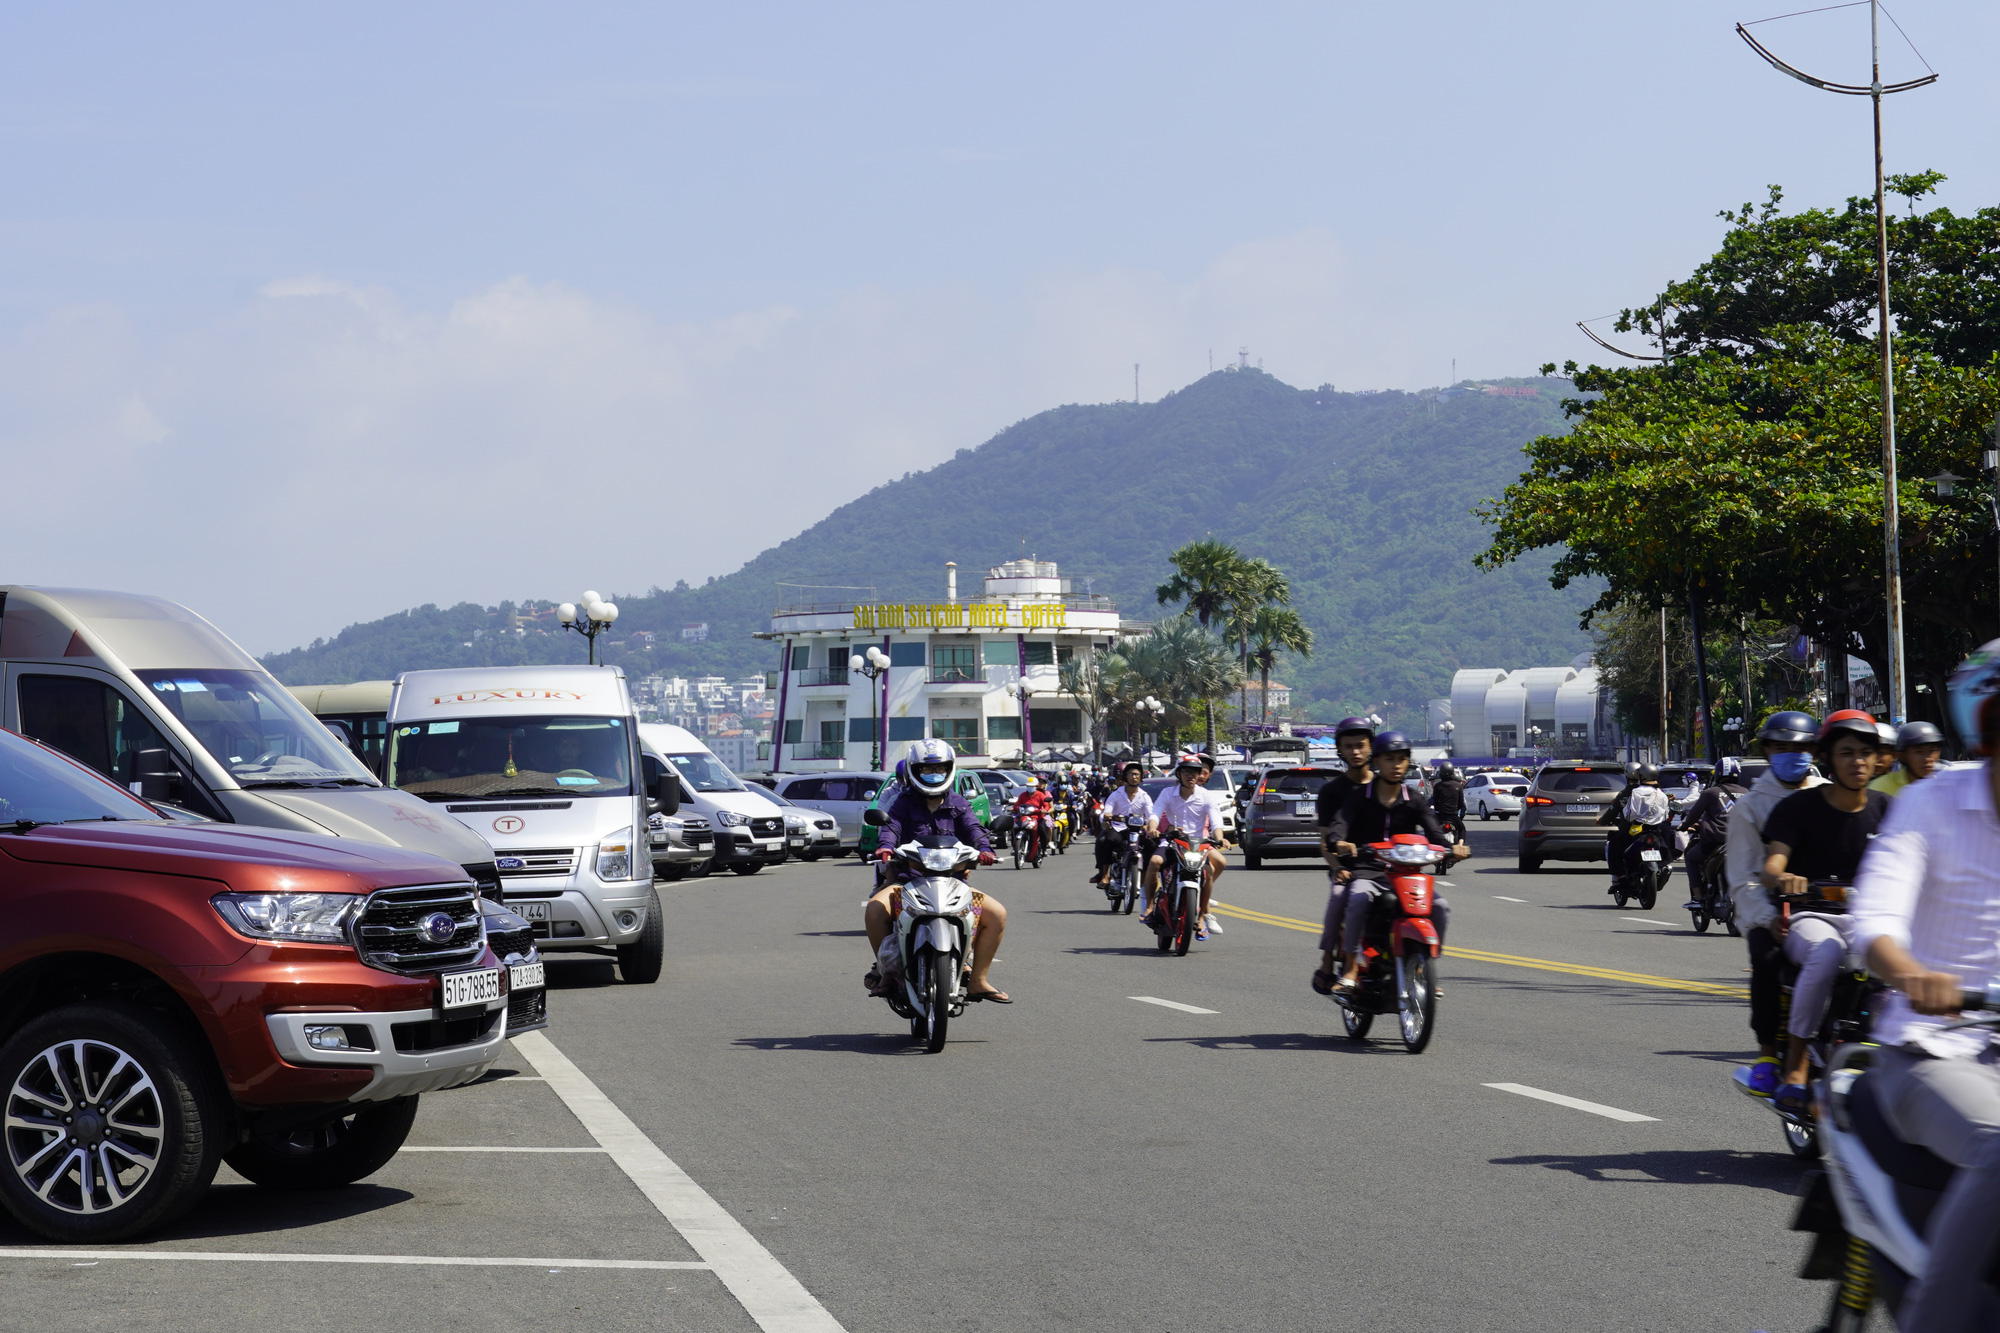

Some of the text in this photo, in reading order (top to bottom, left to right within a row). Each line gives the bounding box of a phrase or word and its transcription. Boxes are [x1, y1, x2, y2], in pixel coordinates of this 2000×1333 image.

[1518, 387, 1538, 396] PARK
[878, 604, 904, 628] GON
[908, 604, 963, 627] SILICON
[969, 603, 1009, 627] HOTEL
[1022, 604, 1067, 627] COFFEE
[434, 691, 587, 704] LUXURY
[501, 820, 516, 829] T
[499, 859, 519, 868] Ford
[446, 972, 498, 1004] 51G-788.55
